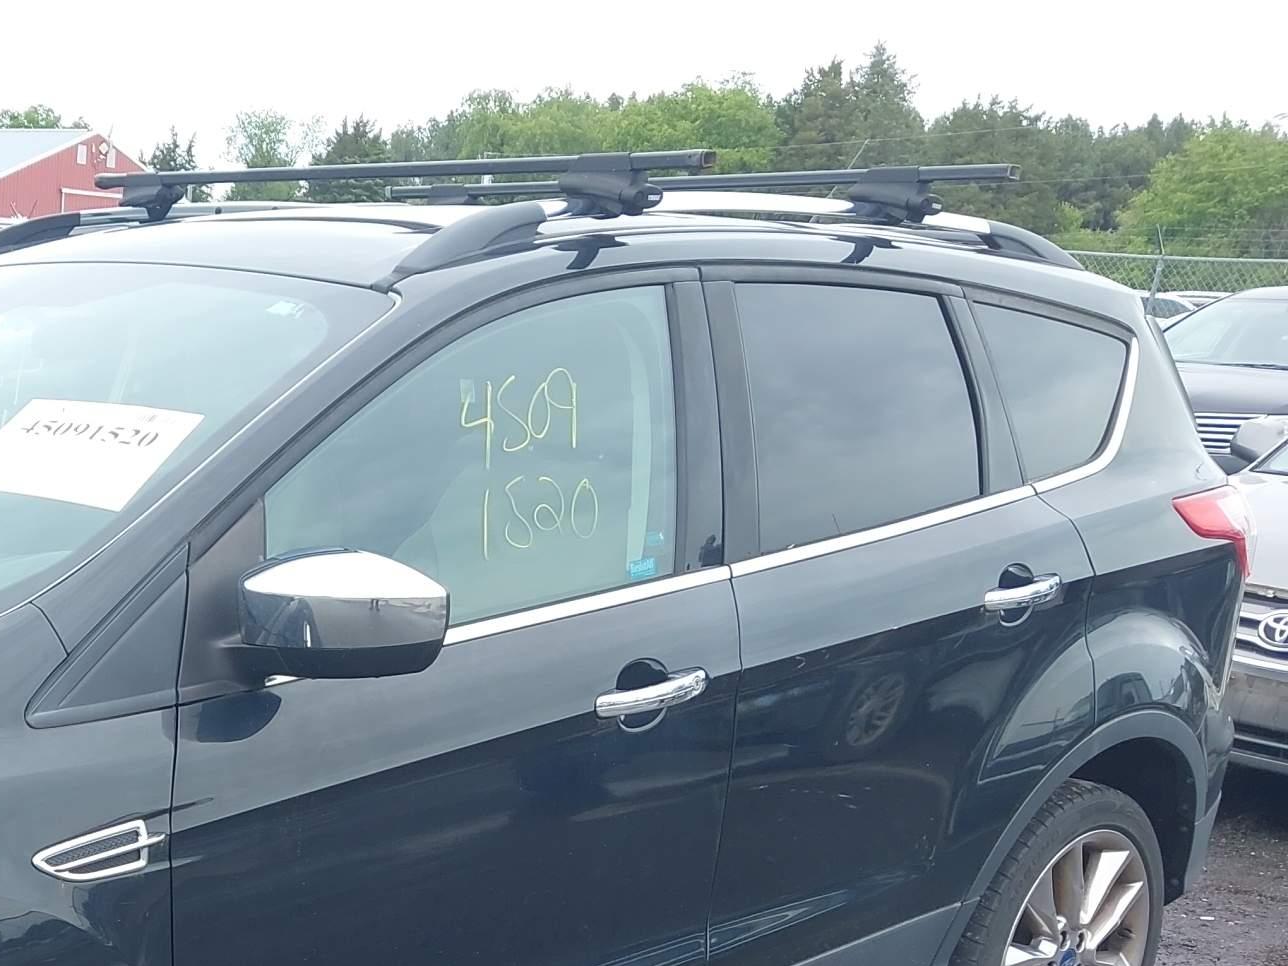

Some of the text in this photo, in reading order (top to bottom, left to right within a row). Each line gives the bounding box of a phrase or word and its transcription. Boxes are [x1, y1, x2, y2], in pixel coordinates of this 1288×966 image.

[20, 419, 160, 447] 45091520
[461, 367, 577, 469] 4509
[483, 475, 599, 561] 1520
